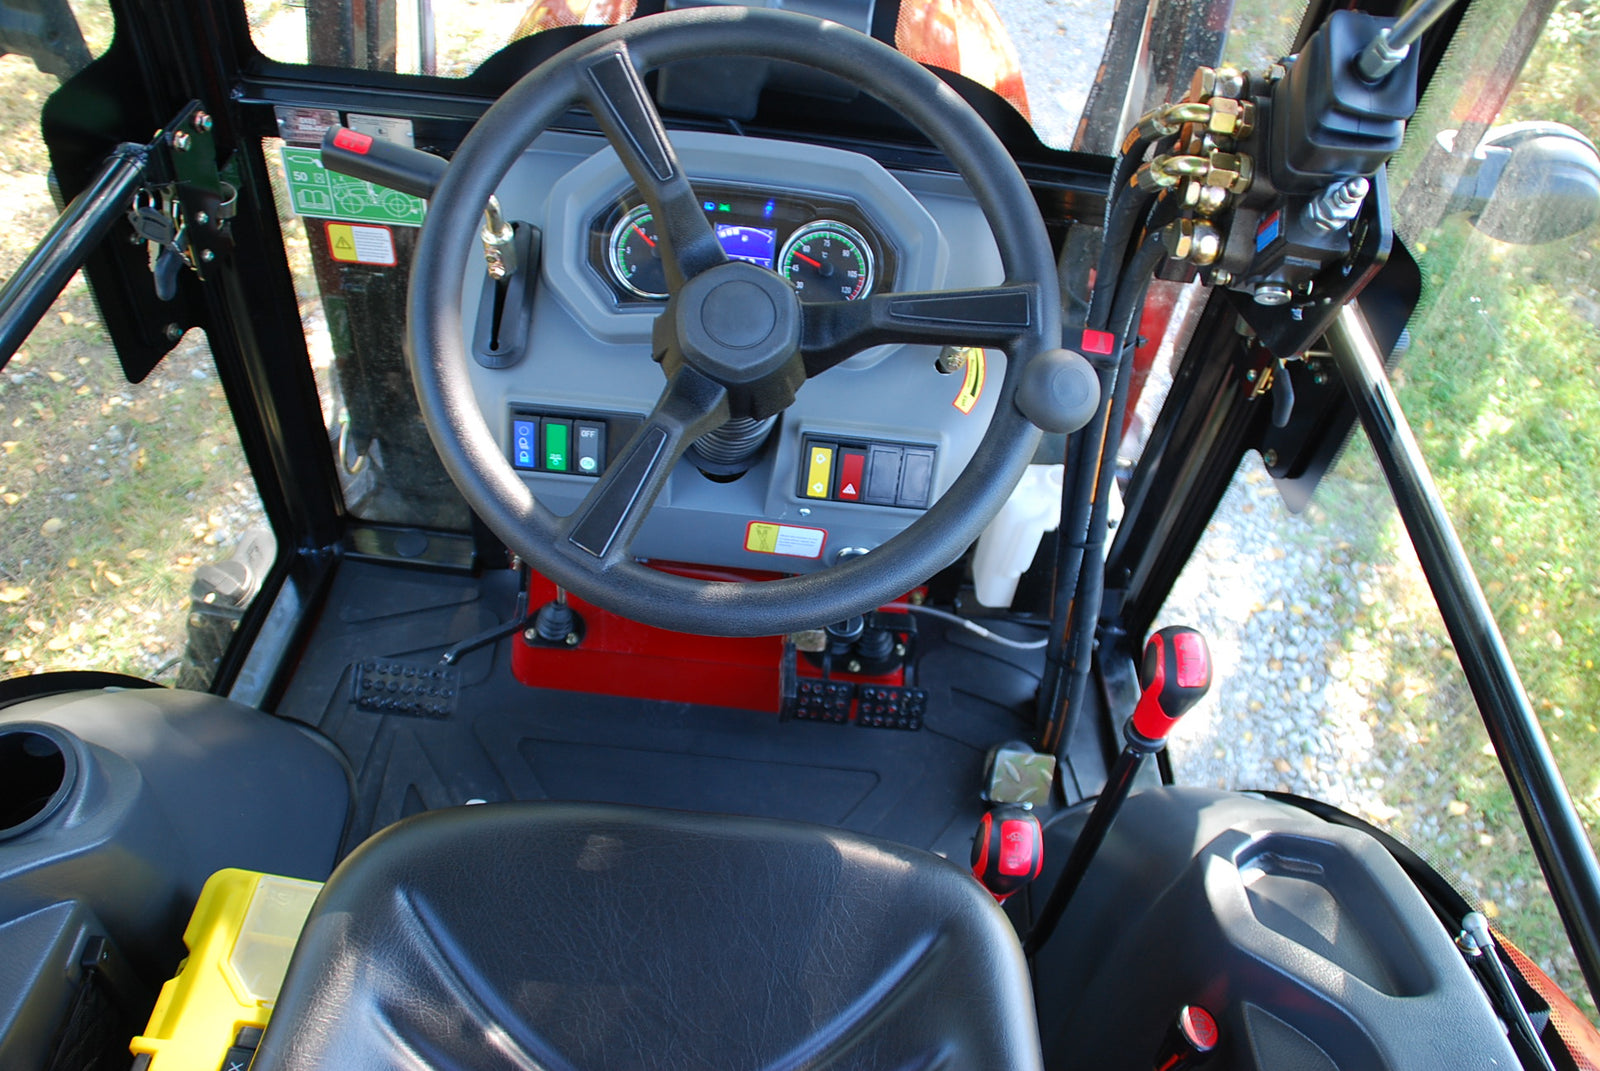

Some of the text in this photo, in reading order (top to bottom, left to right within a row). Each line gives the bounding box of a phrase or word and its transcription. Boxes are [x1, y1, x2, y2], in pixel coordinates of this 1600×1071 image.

[293, 171, 308, 182] 50
[823, 239, 831, 247] 75
[791, 264, 799, 272] 45
[847, 270, 858, 278] 105
[796, 281, 804, 289] 30
[841, 286, 852, 294] 120
[581, 430, 596, 438] OFF
